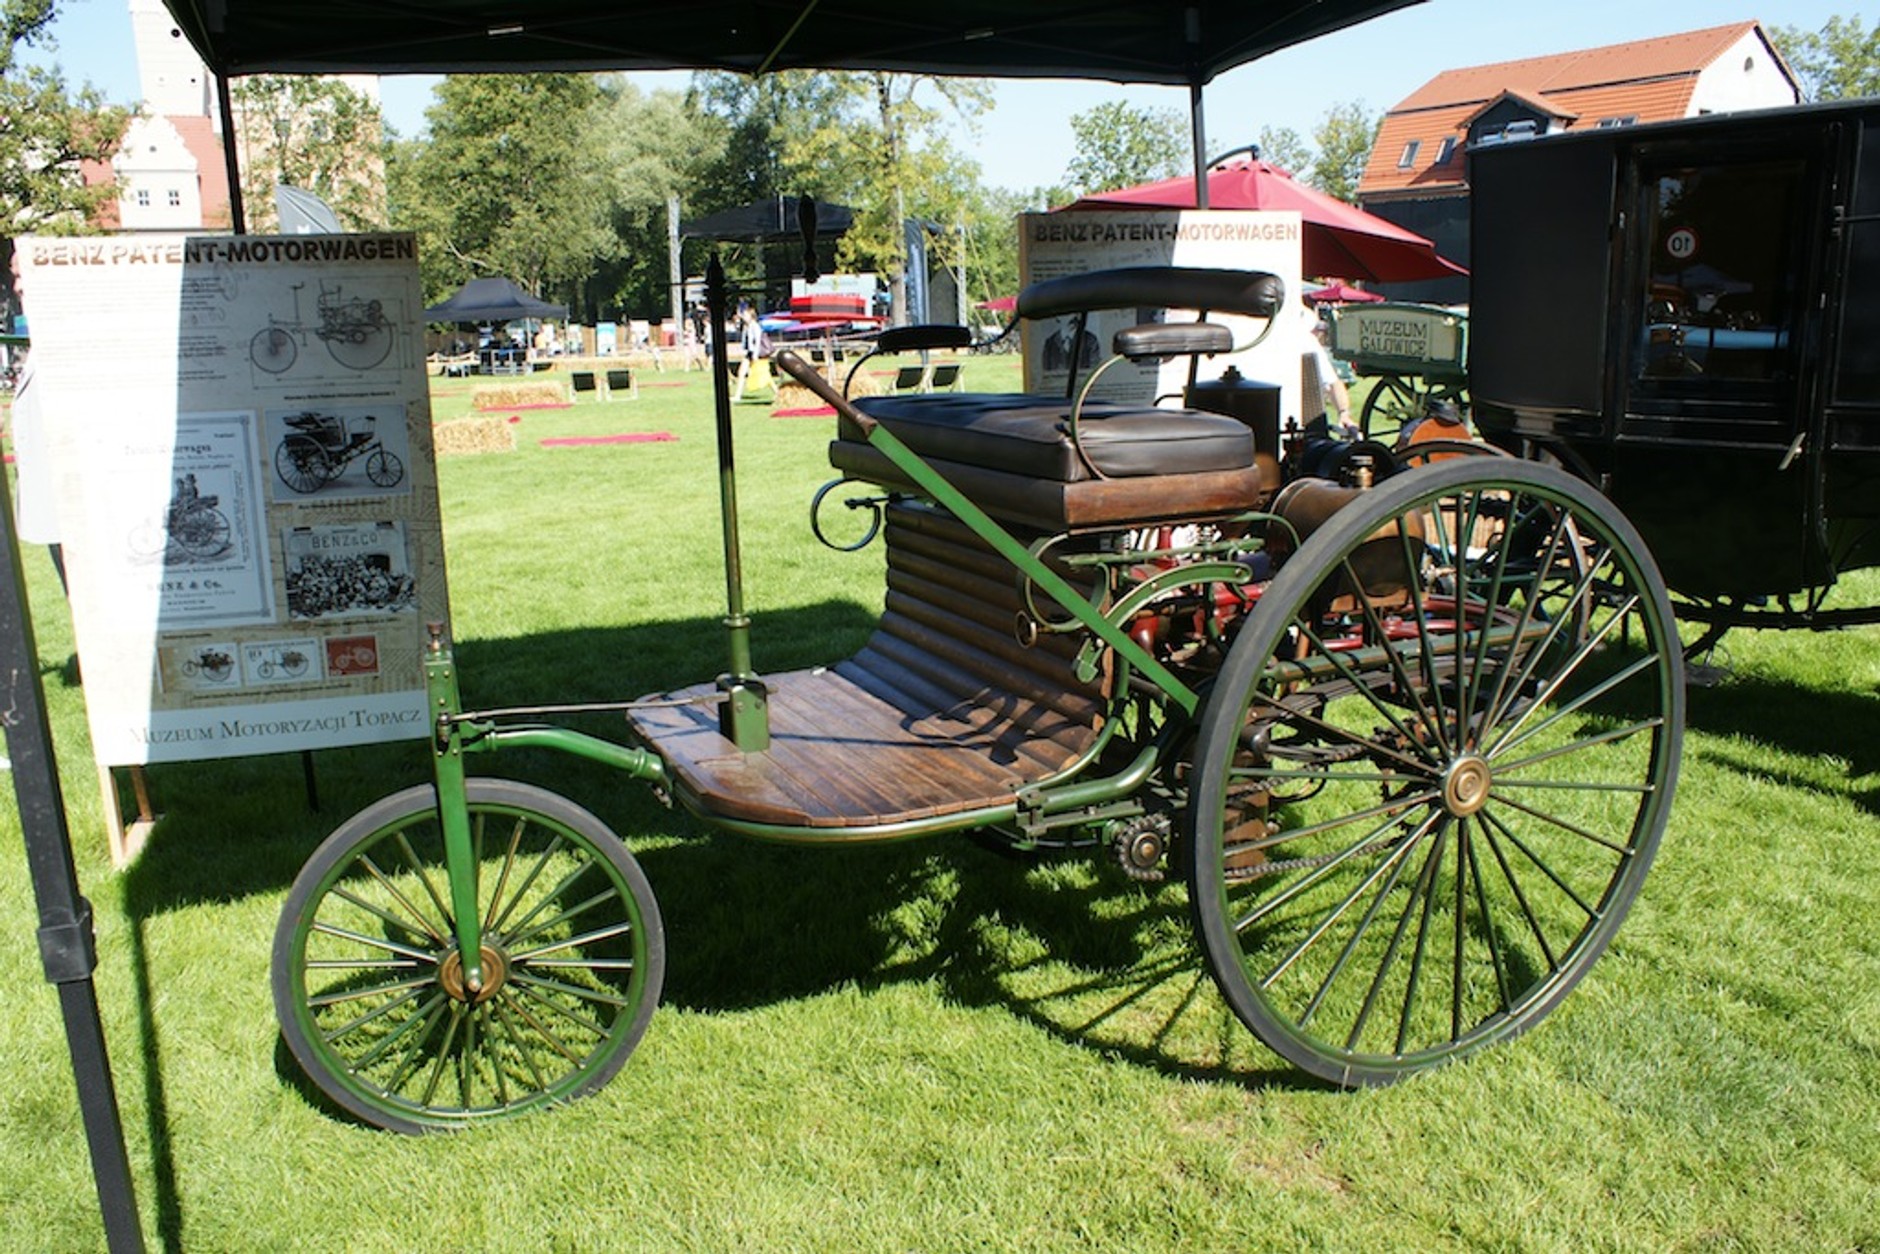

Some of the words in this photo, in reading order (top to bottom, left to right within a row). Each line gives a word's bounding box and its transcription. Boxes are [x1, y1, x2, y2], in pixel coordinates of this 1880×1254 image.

[1036, 222, 1087, 242] BENZ
[1093, 223, 1298, 243] PATENT-MOTORWAGEN
[33, 243, 105, 266] BENZ
[112, 238, 416, 264] PATENT-MOTORWAGEN
[1360, 320, 1427, 339] MUZEUM
[1360, 336, 1426, 356] GALOWICE
[129, 718, 213, 745] MUZEUM
[220, 715, 347, 740] MOTORYZACJI
[350, 708, 423, 729] TOPACZ
